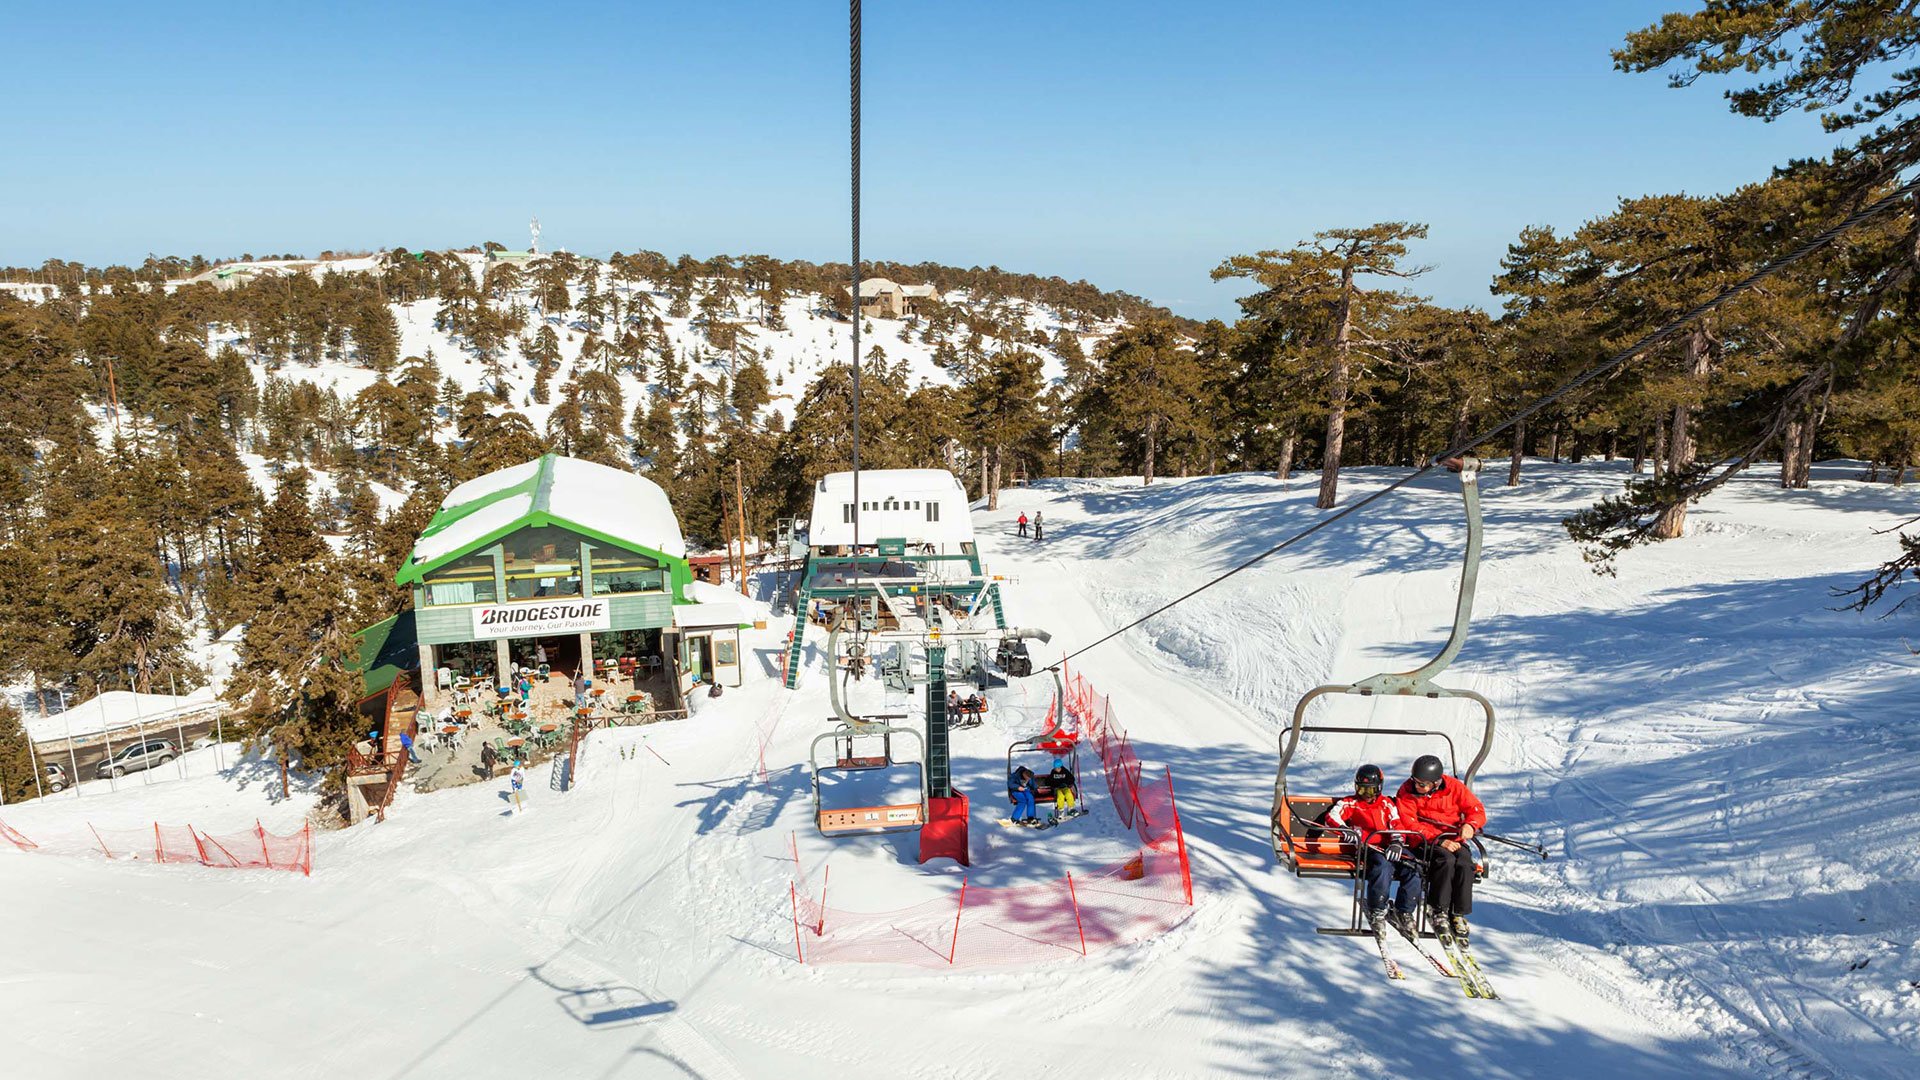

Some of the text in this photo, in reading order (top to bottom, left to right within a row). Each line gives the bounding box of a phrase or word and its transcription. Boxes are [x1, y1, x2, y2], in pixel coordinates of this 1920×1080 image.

[481, 604, 602, 624] BRIDGESTONE
[489, 626, 508, 634] Your
[565, 619, 595, 629] Passion
